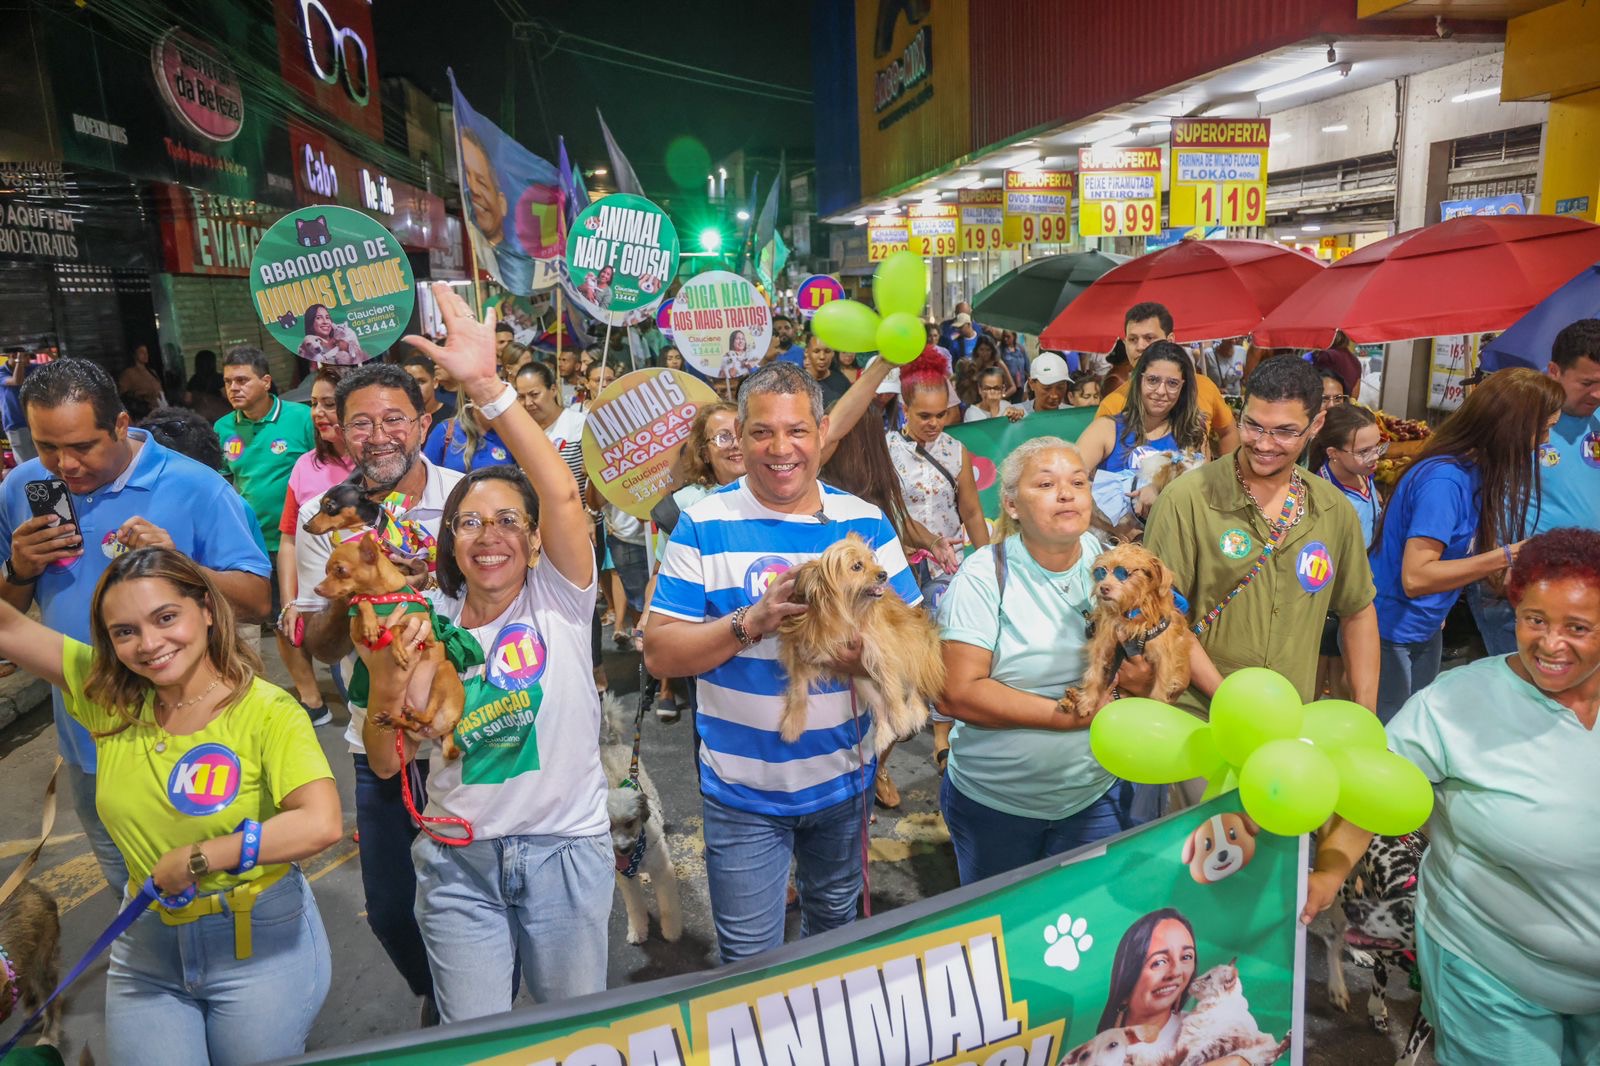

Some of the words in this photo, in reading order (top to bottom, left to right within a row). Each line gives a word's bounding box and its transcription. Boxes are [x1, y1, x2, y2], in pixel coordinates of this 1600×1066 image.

[176, 71, 195, 103] da
[197, 78, 241, 121] Beleza
[1175, 122, 1267, 144] SUPEROFERTA
[304, 143, 339, 198] Cabo
[1081, 151, 1159, 168] SUROFERTA
[1179, 154, 1204, 167] FARINHA
[1205, 154, 1213, 167] DE
[1234, 154, 1260, 167] FLOCADA
[1182, 167, 1237, 180] FLOKÃO
[362, 168, 395, 216] Reife
[960, 189, 1003, 202] SUPEROFE
[1008, 173, 1072, 188] SUROFERTA
[1085, 177, 1106, 190] PEIXE
[1107, 176, 1154, 189] PIRAMUTABA
[1090, 190, 1134, 199] INTEIRO
[1008, 194, 1030, 203] OVOS
[1032, 195, 1066, 206] TAMAGO
[595, 205, 662, 248] ANIMAL
[1023, 216, 1066, 242] 9,99
[1103, 203, 1154, 235] 9,99
[259, 243, 359, 285] ABANDONO
[362, 236, 390, 260] DE
[573, 235, 608, 271] NÃO
[620, 243, 671, 282] COISA
[255, 273, 337, 325] ANIMAIS
[332, 267, 351, 306] É
[346, 257, 410, 303] CRIME
[685, 283, 718, 310] DIGA
[721, 279, 752, 307] NÃO
[809, 287, 833, 307] 11
[346, 303, 396, 321] Claucione
[356, 318, 397, 337] 13444
[673, 310, 693, 331] AOS
[694, 308, 724, 330] MAUS
[724, 305, 768, 329] TRATOS!
[586, 369, 686, 449] ANIMAIS
[602, 430, 653, 465] NÃO
[652, 403, 697, 437] SÃO
[621, 458, 671, 489] Claucione
[633, 474, 675, 503] 13444
[1299, 551, 1328, 582] K11
[490, 637, 539, 676] K11
[456, 689, 532, 736] CASTRAÇÃO
[483, 706, 535, 737] SOLUÇÃO
[172, 762, 232, 797] K11
[706, 932, 1020, 1066] ANIMAL
